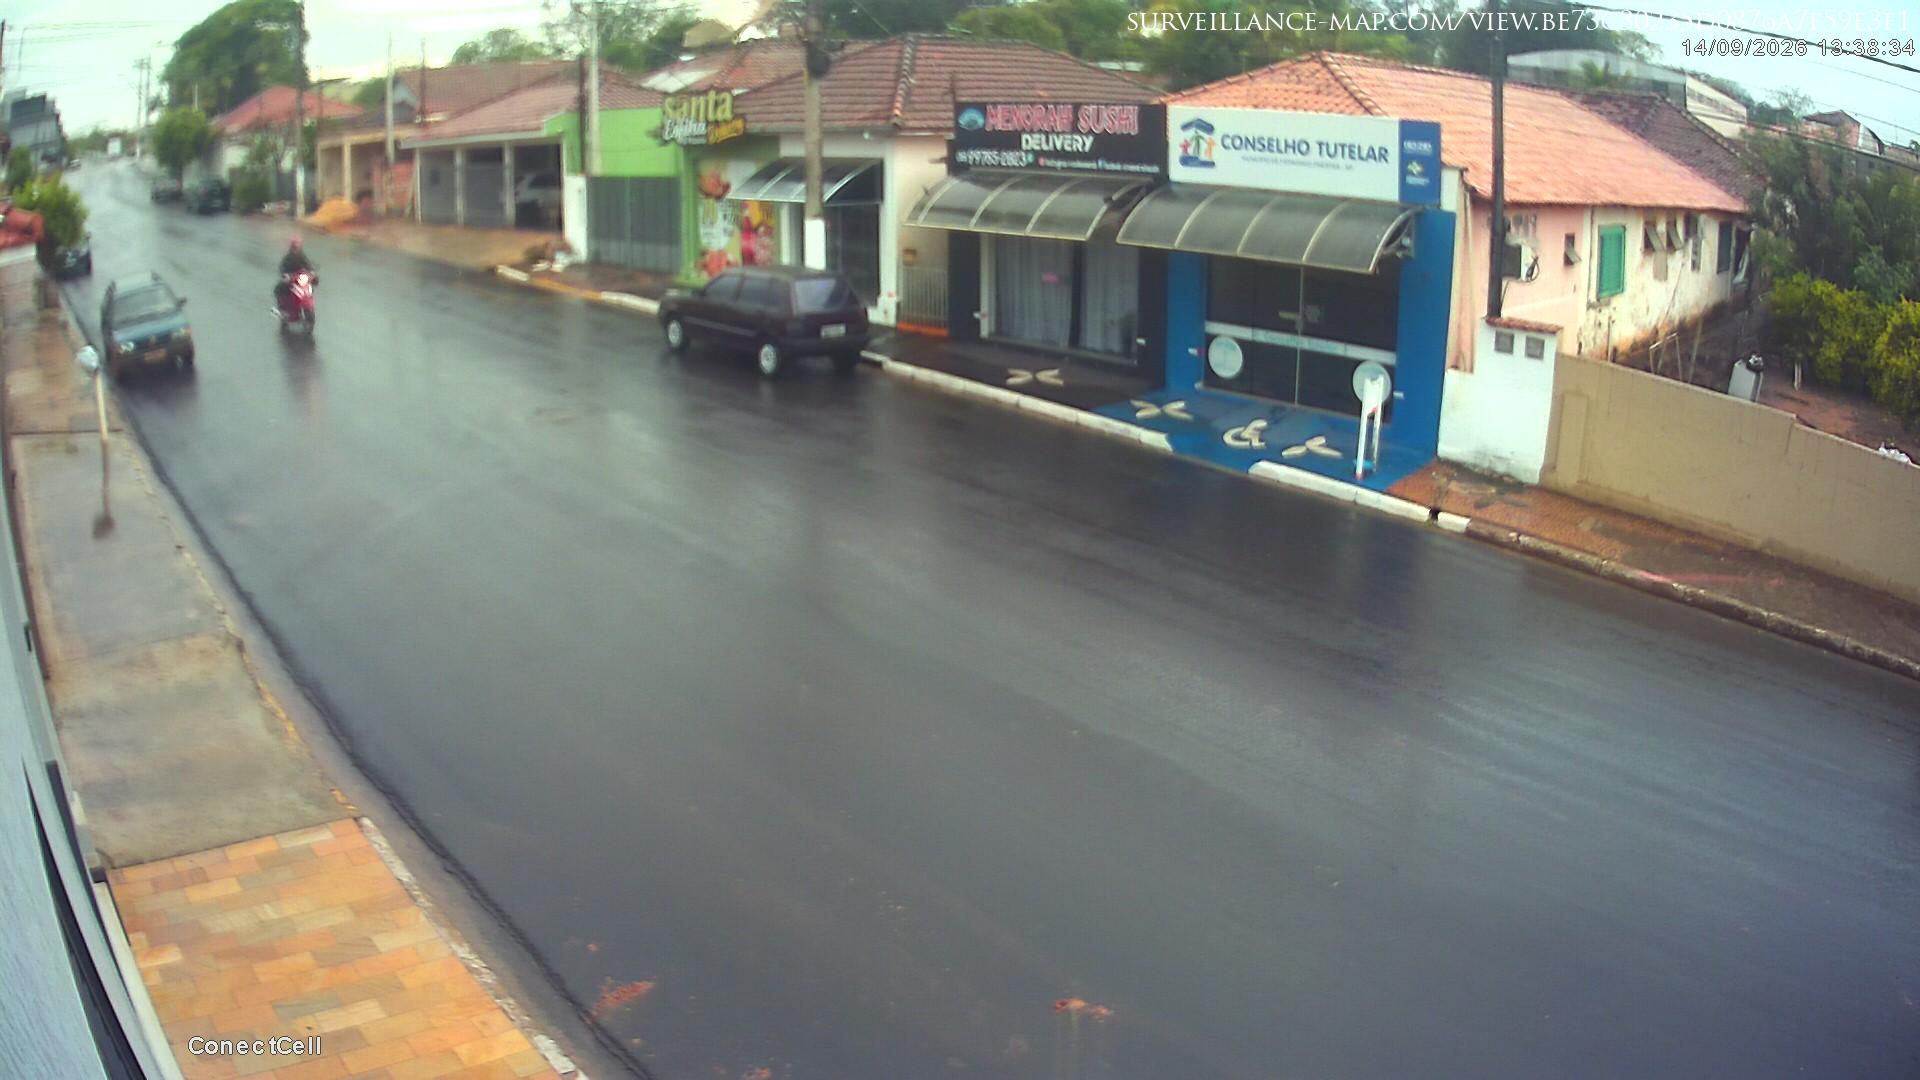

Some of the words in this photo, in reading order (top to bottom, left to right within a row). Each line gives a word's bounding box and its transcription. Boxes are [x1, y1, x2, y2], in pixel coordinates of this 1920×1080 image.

[985, 104, 1074, 133] MENORAH
[1077, 105, 1140, 135] SUSHI
[1021, 133, 1094, 153] DELIVERY
[1221, 133, 1311, 157] CONSELHO
[1317, 140, 1390, 164] TUTELAR
